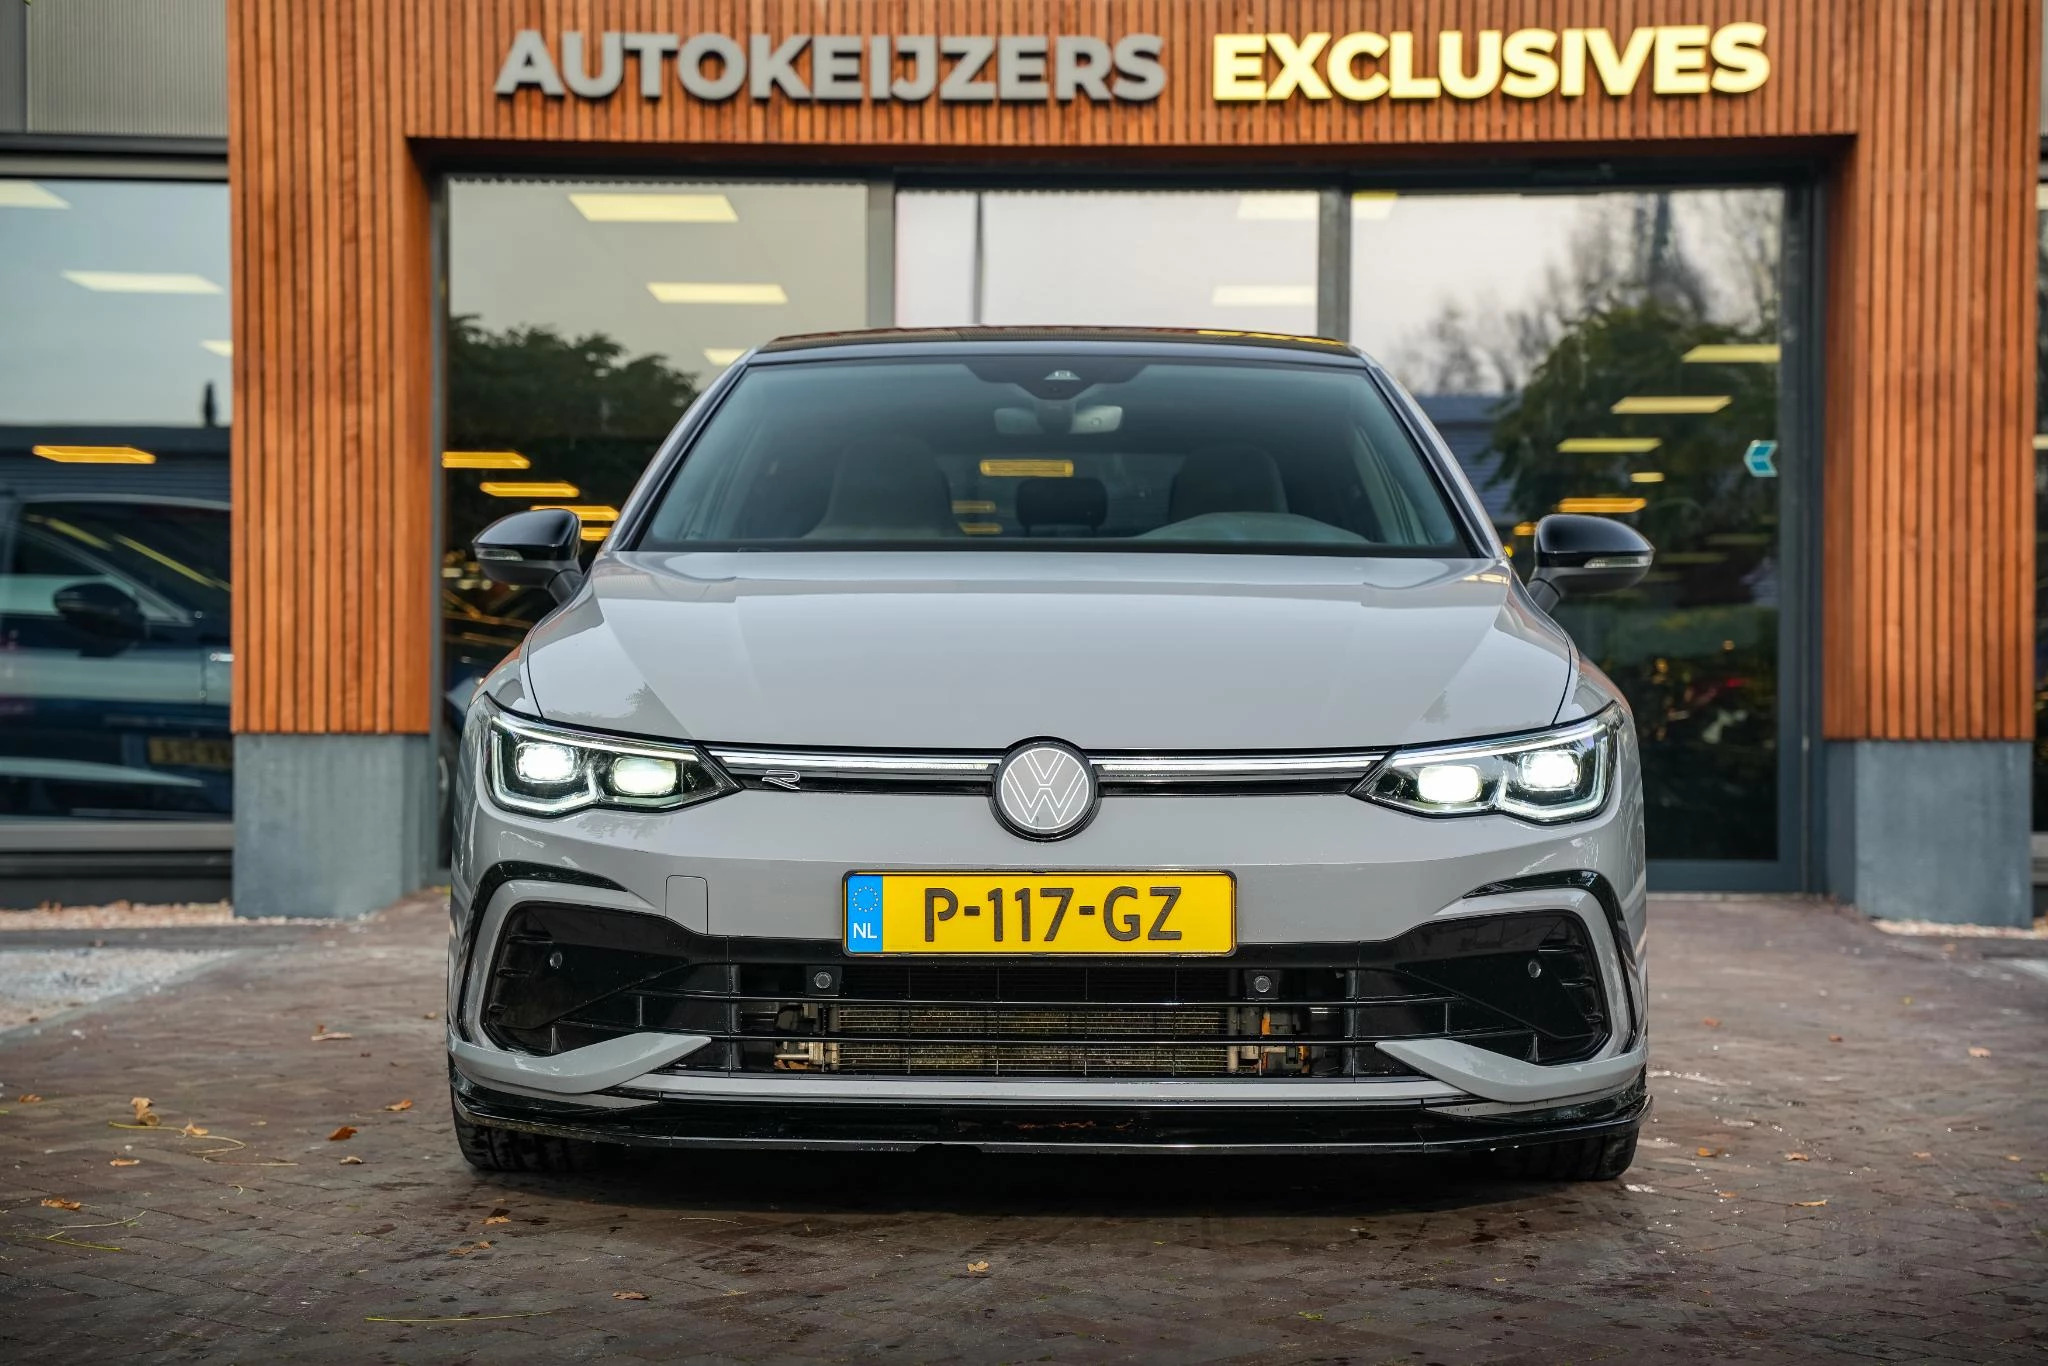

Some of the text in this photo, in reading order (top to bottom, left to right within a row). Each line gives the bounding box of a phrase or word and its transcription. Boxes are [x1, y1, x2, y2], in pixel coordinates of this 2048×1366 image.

[494, 22, 1770, 101] AUTOKEIJZERS EXCLUSIVES
[853, 922, 878, 939] NL
[924, 886, 1183, 942] P-117-GZ
